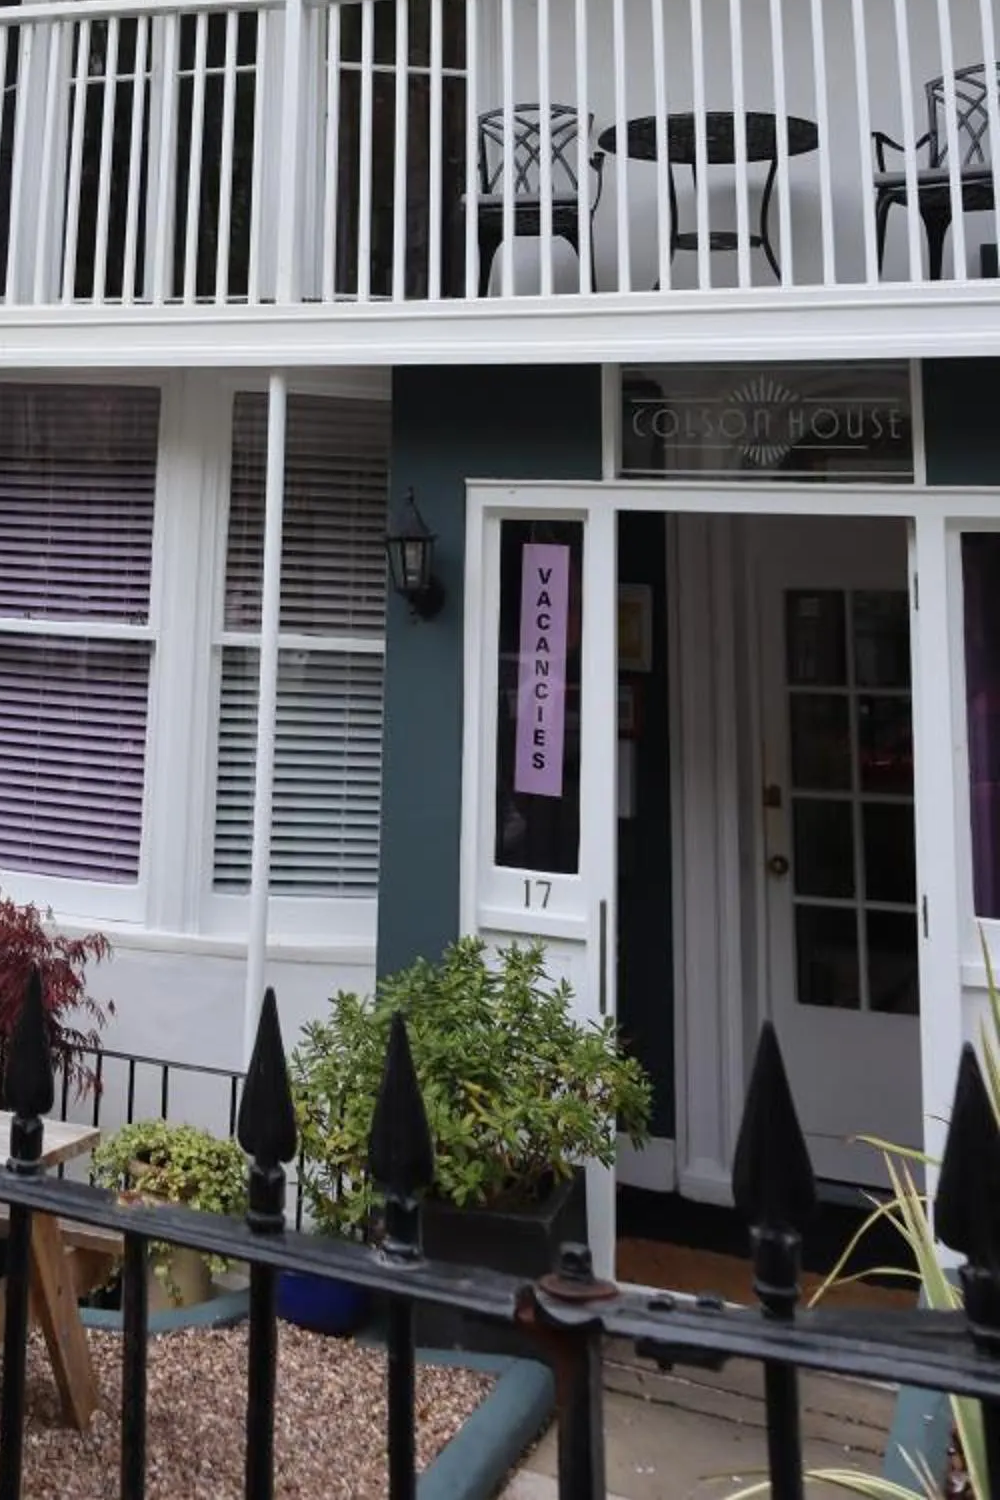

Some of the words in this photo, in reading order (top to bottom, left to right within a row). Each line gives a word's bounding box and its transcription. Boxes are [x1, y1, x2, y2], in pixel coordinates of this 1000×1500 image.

[632, 409, 770, 438] COLSON
[788, 408, 902, 438] HOUSE
[531, 566, 553, 771] VACANCIES
[523, 878, 552, 910] 17
